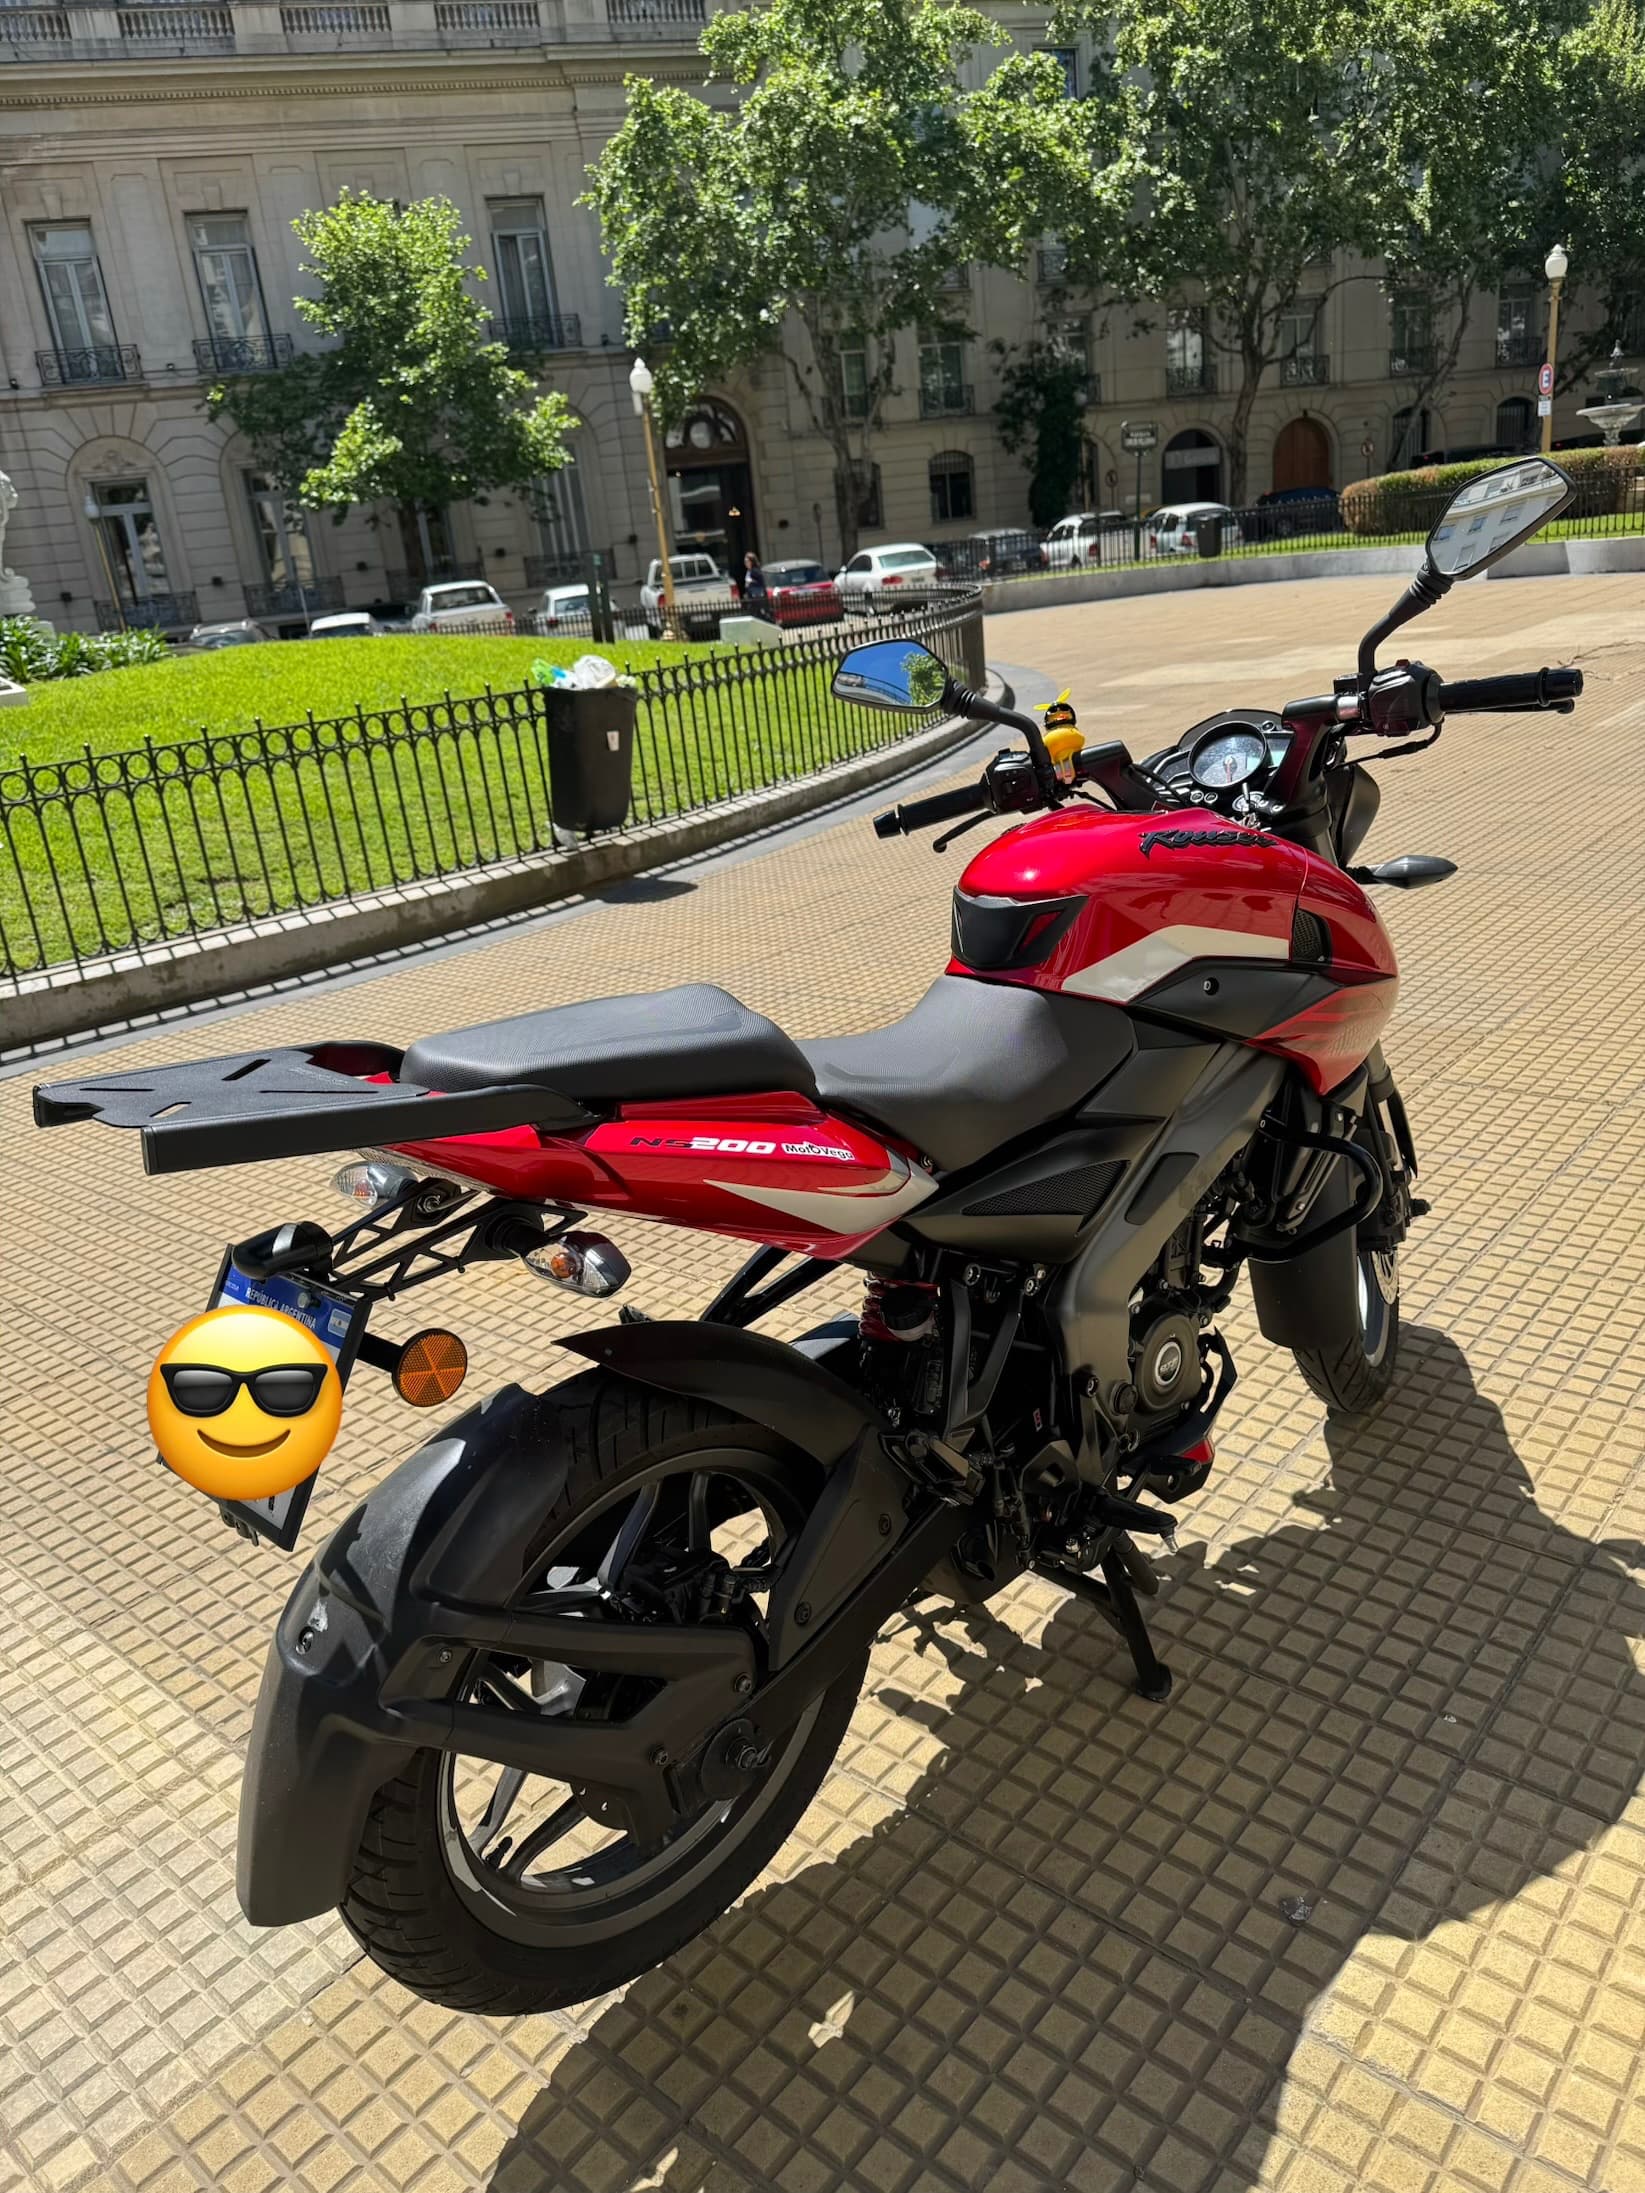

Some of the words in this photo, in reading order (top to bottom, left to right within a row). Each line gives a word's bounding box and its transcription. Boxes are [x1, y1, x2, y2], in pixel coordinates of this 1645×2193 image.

[1542, 370, 1551, 388] E
[630, 1136, 777, 1155] NS200
[280, 1303, 317, 1329] ARGENTINA
